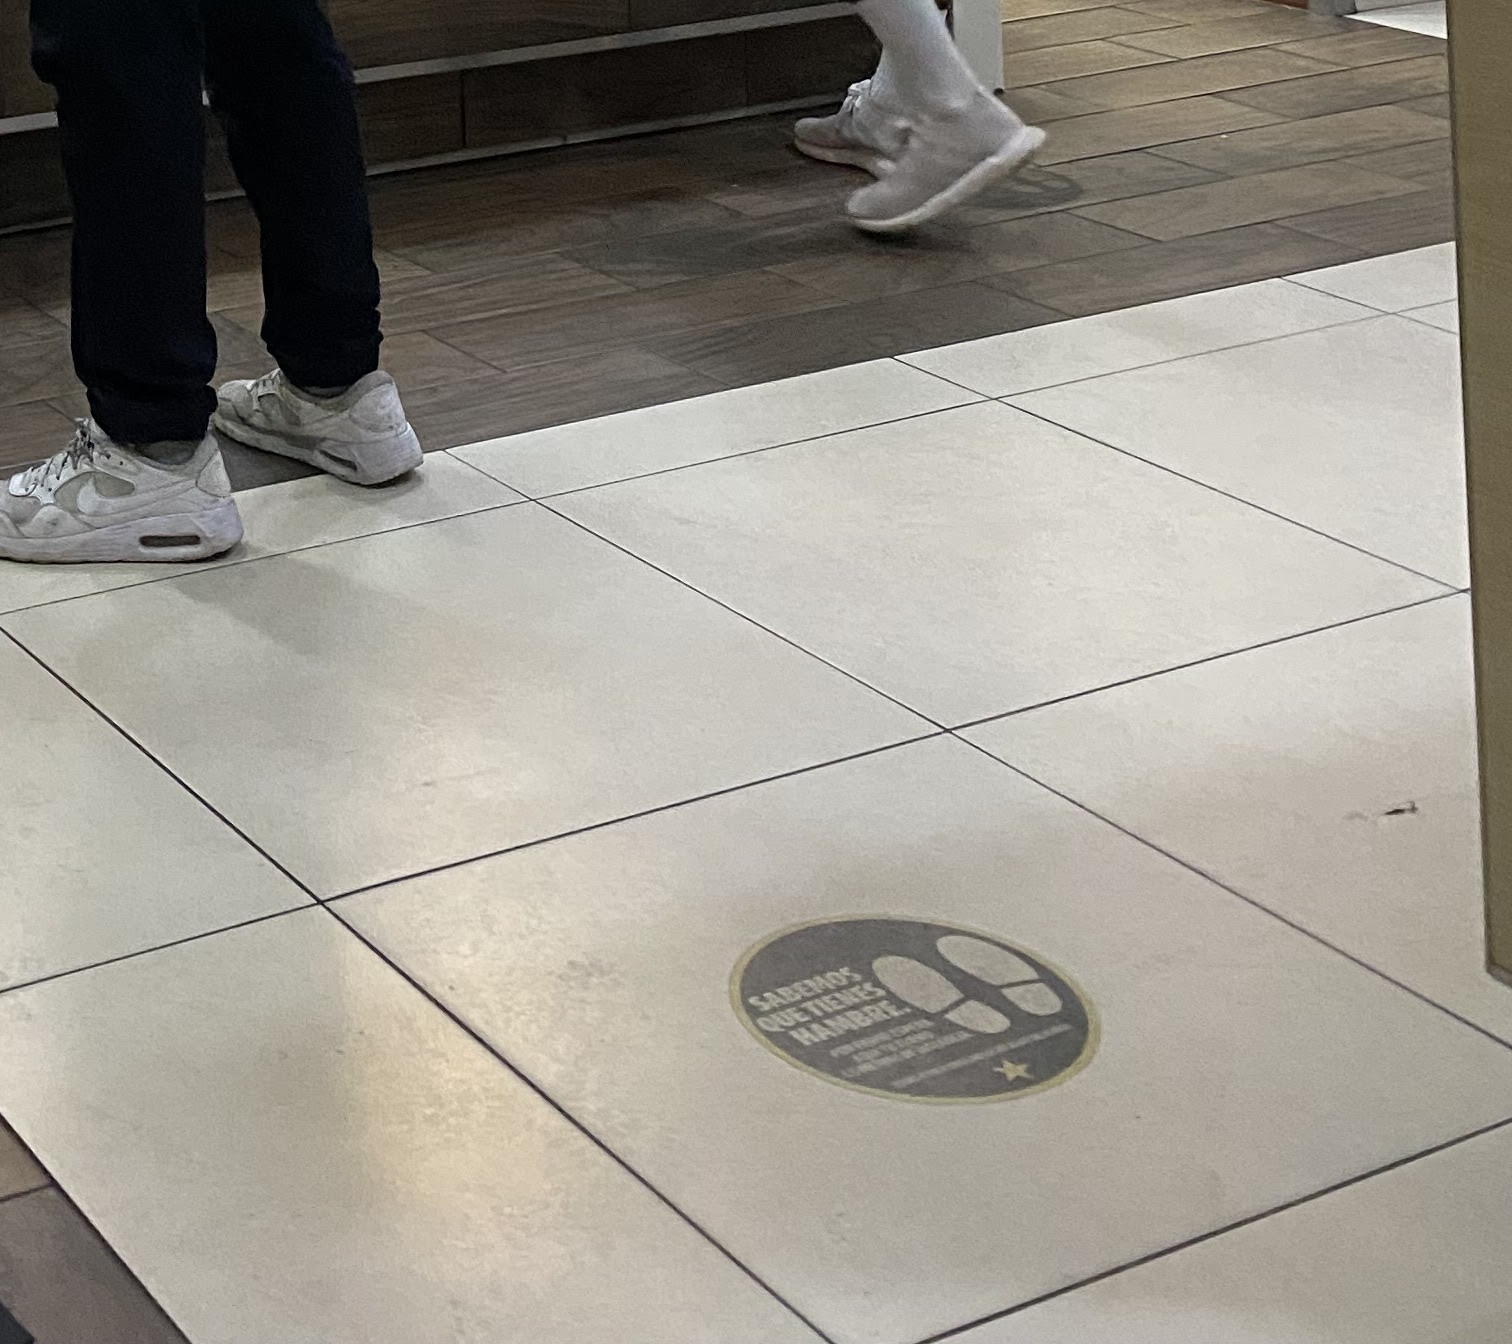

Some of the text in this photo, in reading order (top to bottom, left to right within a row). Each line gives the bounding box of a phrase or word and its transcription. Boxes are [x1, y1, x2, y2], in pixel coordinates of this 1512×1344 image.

[748, 966, 863, 1012] SABEMOS
[756, 981, 887, 1033] QUE TIENES
